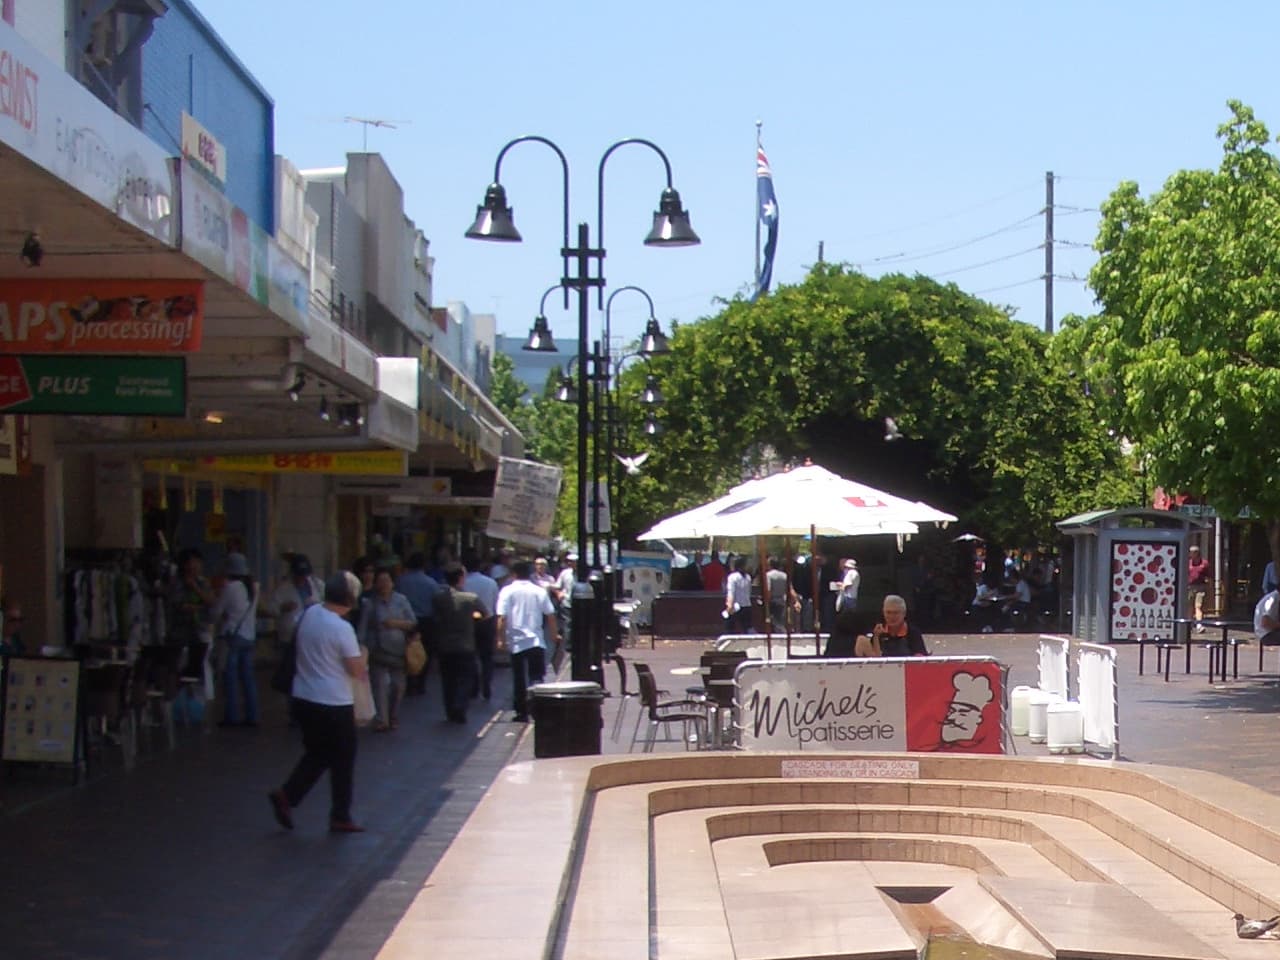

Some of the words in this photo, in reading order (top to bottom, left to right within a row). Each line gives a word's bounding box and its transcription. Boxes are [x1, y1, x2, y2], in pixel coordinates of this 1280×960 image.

[71, 315, 193, 345] processing!
[37, 376, 92, 395] PLUS
[750, 684, 877, 738] Michel's
[799, 720, 894, 749] patisserie
